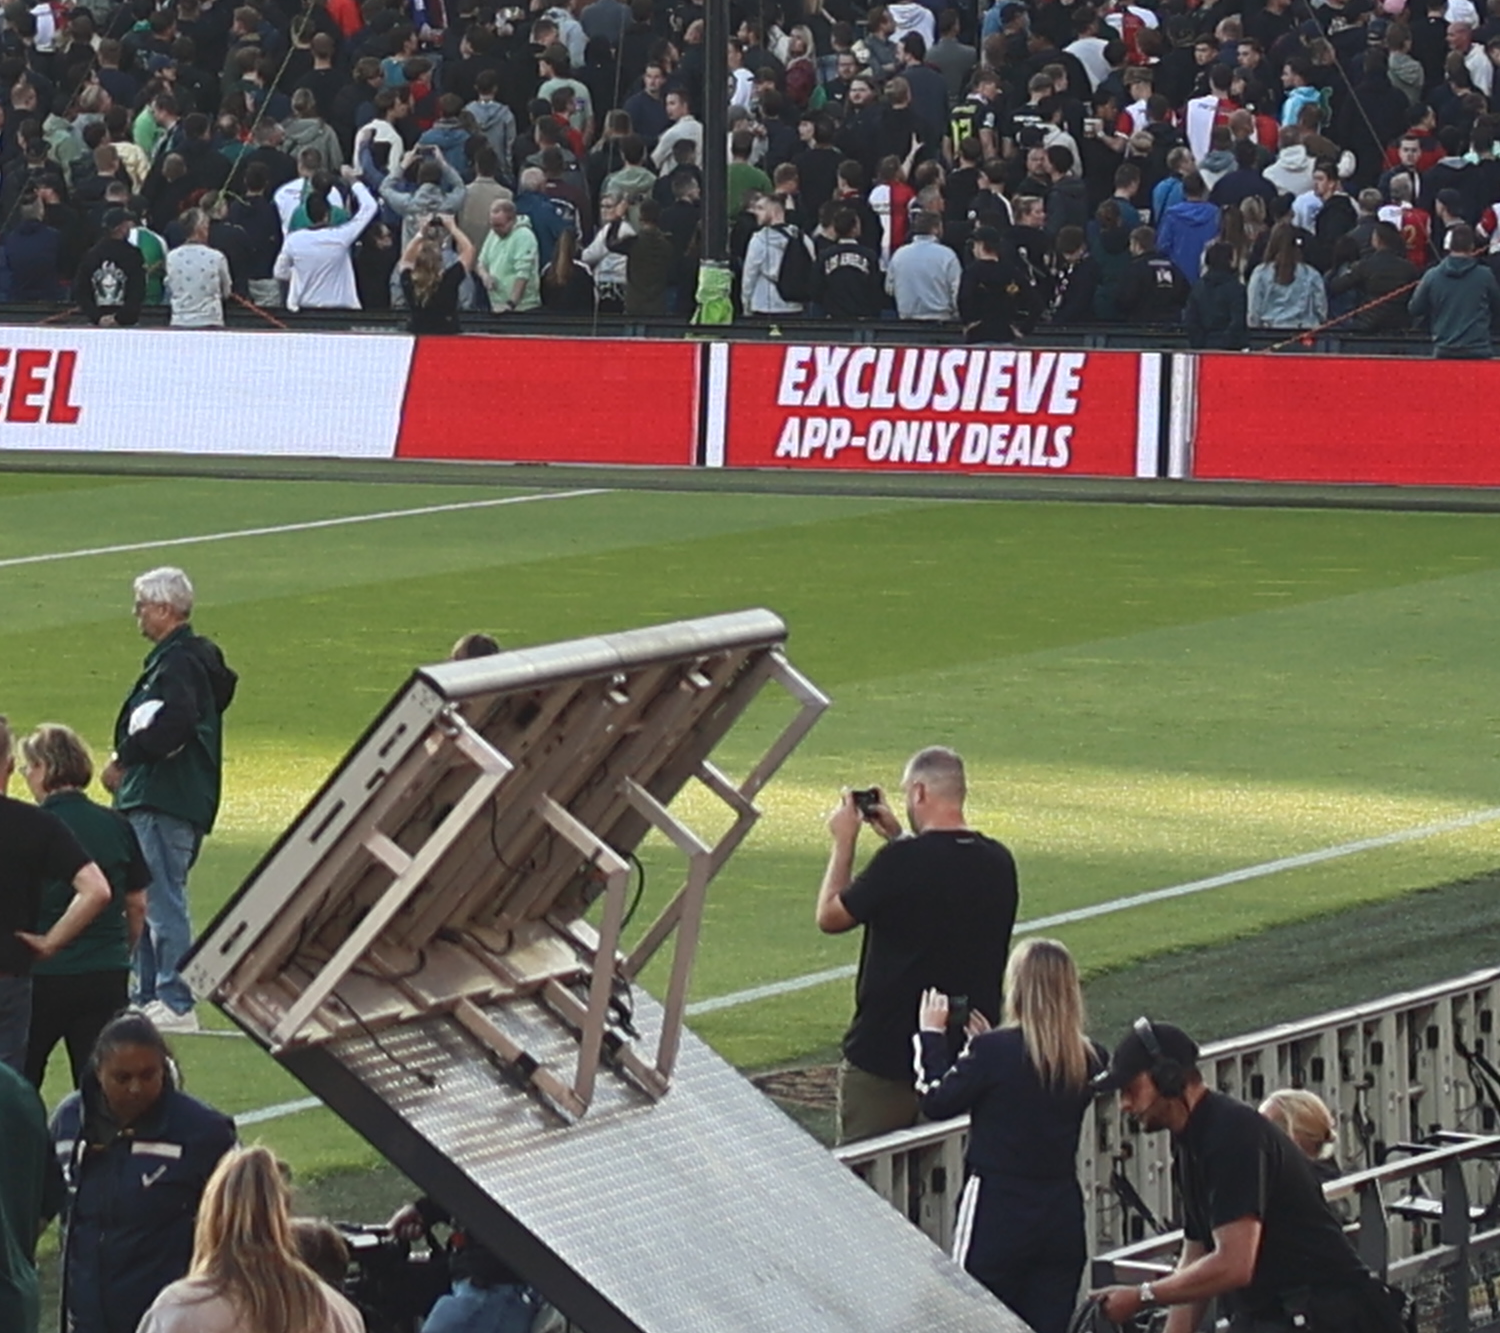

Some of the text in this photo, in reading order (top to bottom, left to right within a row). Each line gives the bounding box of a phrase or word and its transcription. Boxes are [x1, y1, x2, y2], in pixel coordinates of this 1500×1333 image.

[777, 346, 1086, 415] EXCLUSIEVE
[775, 416, 1072, 468] APP-ONLY DEALS
